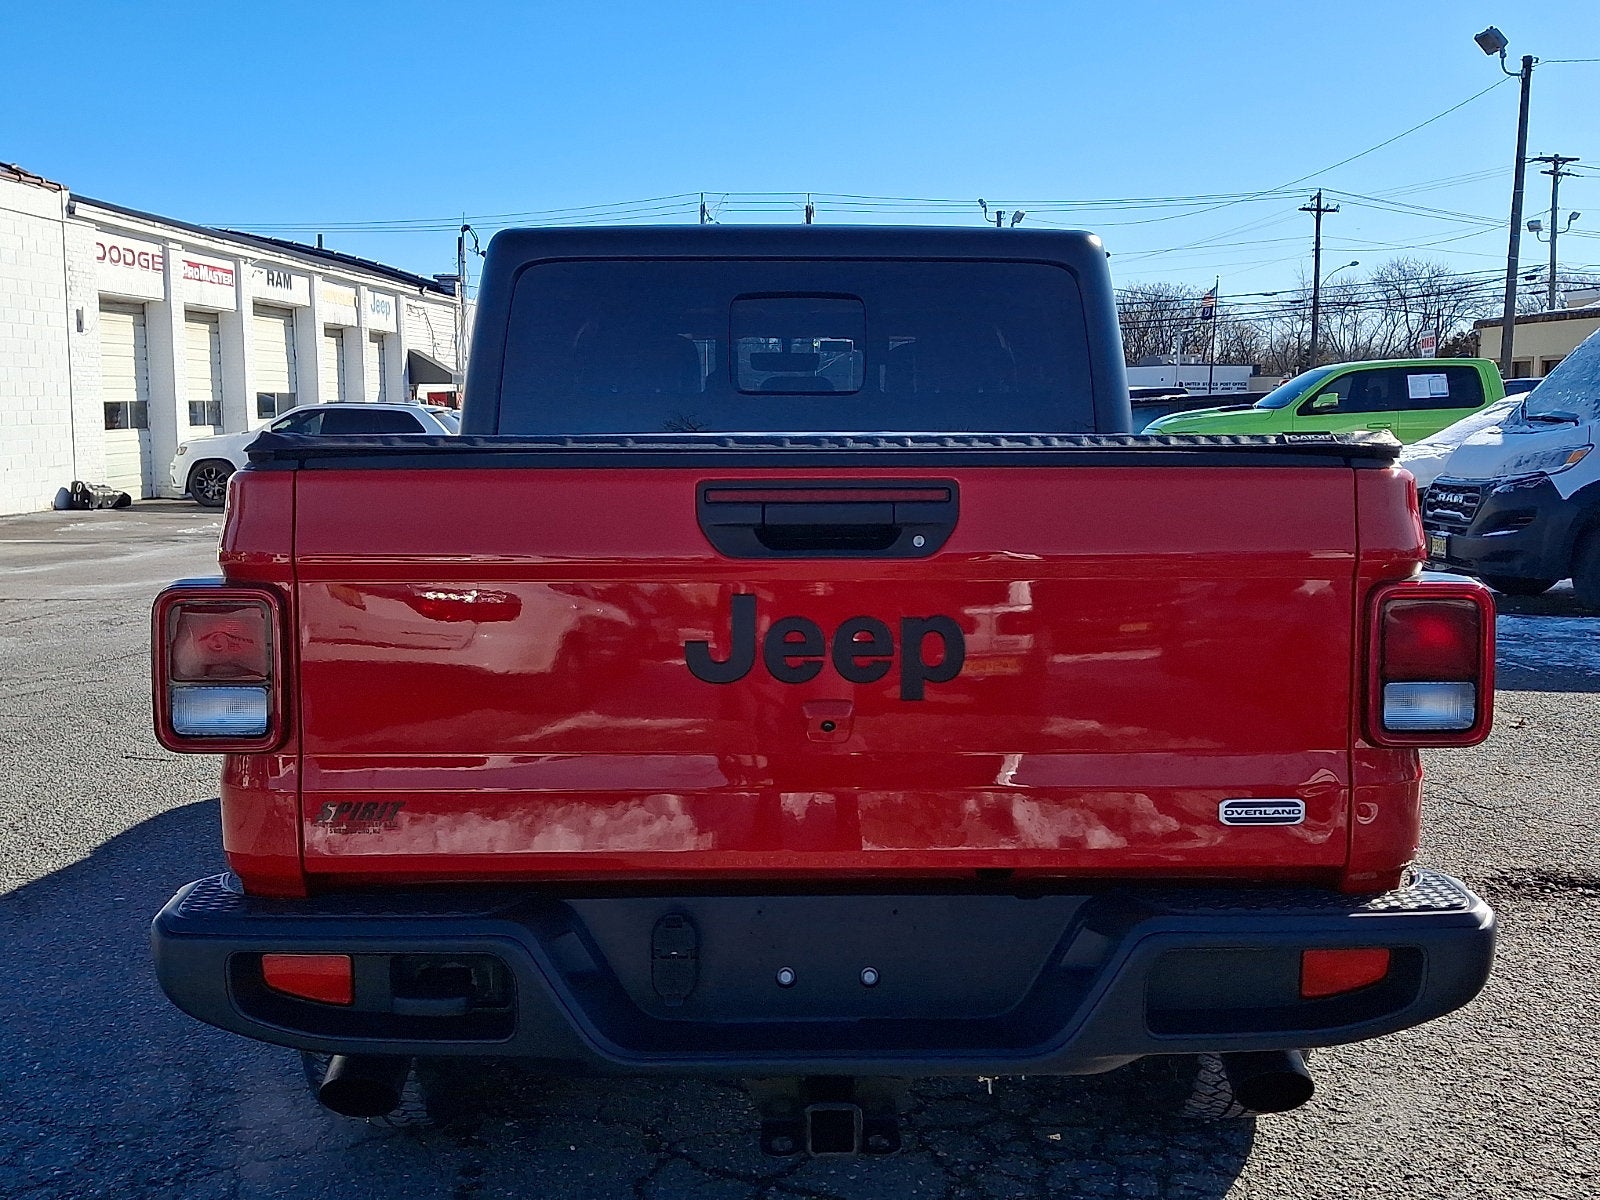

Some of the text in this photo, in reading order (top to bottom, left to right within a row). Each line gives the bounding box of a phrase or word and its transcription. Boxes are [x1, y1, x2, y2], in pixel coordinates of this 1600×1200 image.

[96, 242, 163, 272] DODGE
[266, 269, 292, 291] RAM
[370, 291, 391, 321] Jeep
[1436, 492, 1464, 503] RAM
[685, 593, 966, 701] Jeep
[316, 801, 405, 822] SPIRIT
[1223, 808, 1302, 817] OVERLAND
